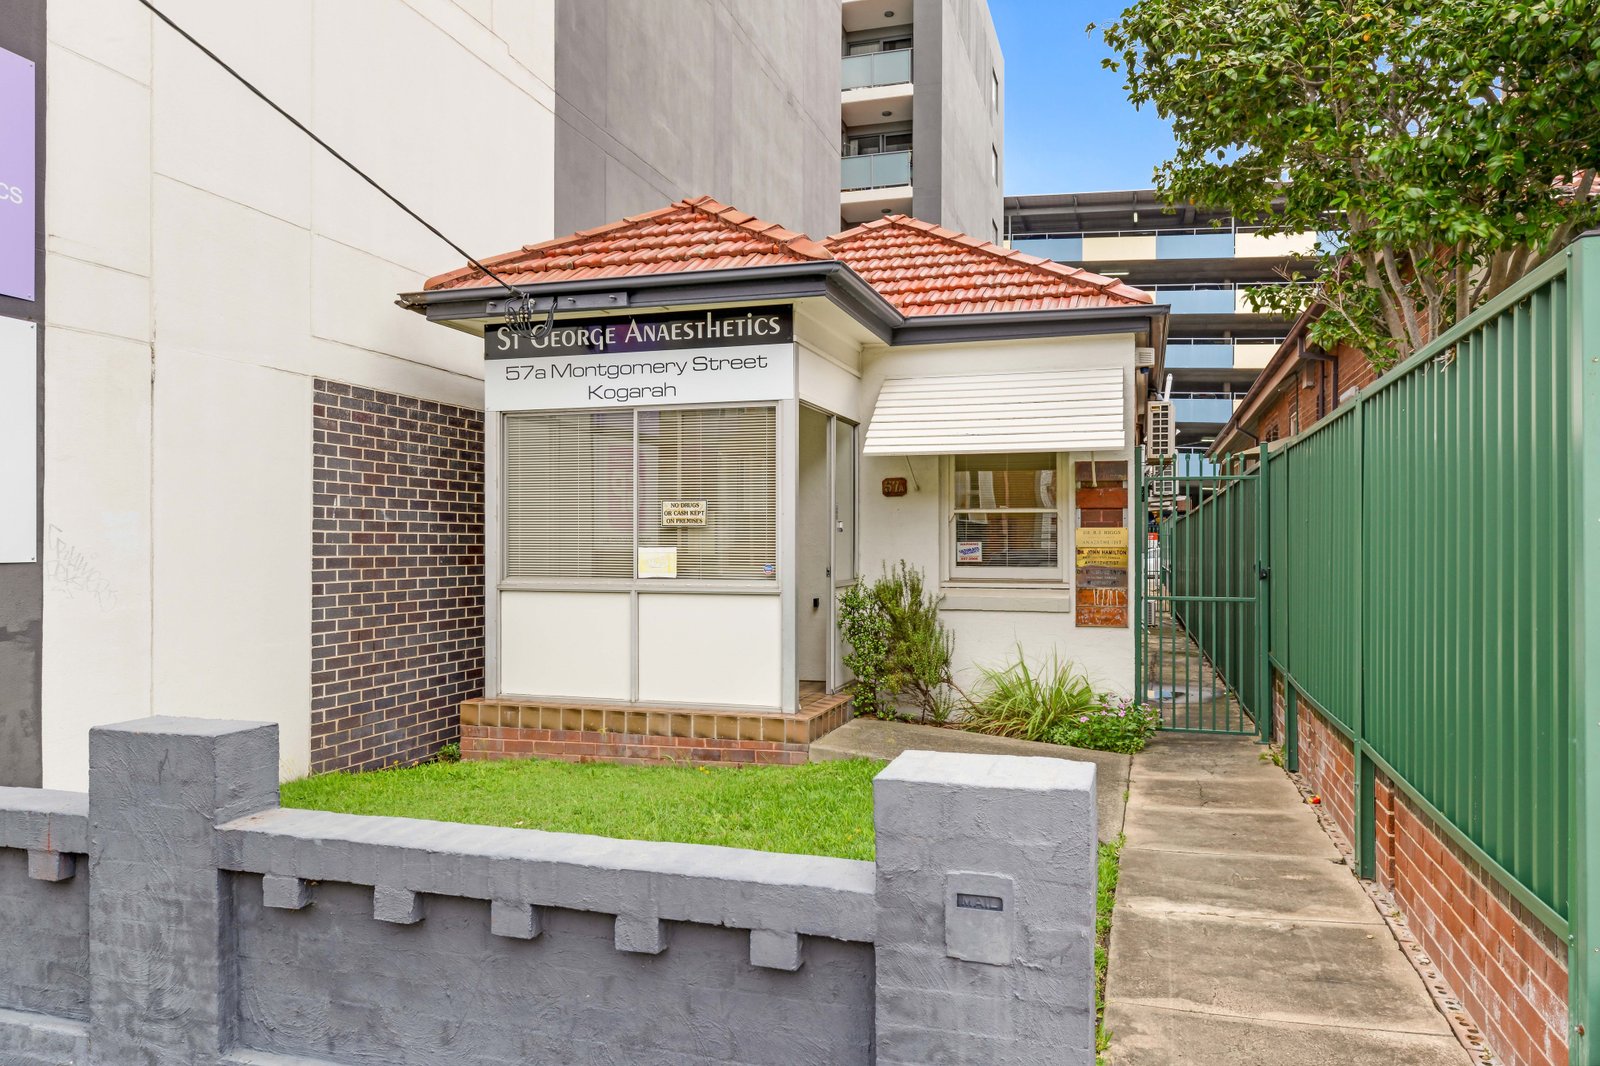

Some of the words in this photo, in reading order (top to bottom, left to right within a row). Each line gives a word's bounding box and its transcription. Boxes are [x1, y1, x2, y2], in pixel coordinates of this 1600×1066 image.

[531, 324, 616, 351] GEORGE
[505, 364, 546, 381] 57a
[551, 358, 688, 380] Montgomery
[692, 354, 768, 372] Street
[588, 382, 677, 402] Kogarah
